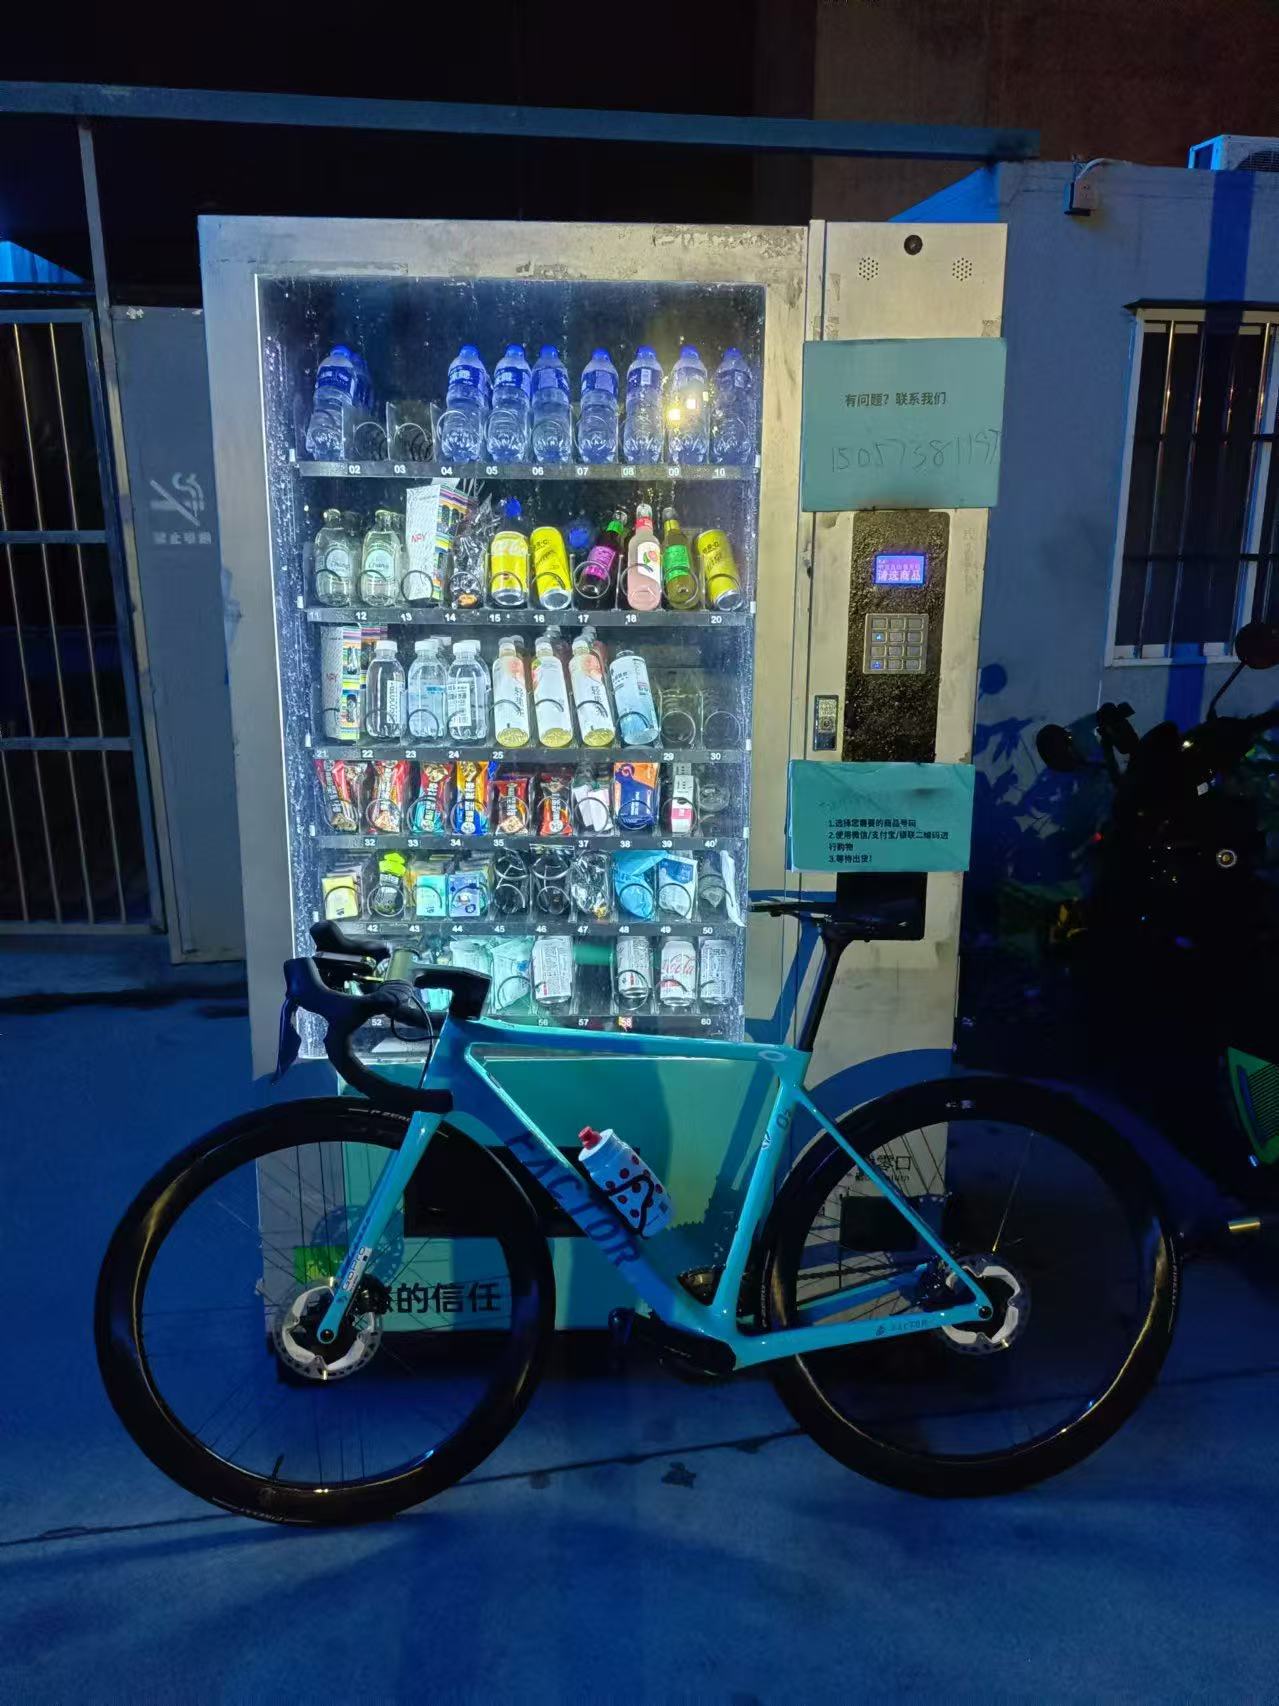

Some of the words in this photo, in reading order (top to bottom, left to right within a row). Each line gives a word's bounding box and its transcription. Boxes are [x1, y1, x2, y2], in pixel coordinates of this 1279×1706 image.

[349, 465, 361, 475] 02
[394, 465, 406, 474] 03
[441, 466, 453, 475] 04
[486, 466, 498, 475] 05
[532, 467, 543, 475] 06
[577, 467, 589, 475] 07
[623, 467, 634, 476] 08
[669, 467, 680, 476] 09
[714, 468, 726, 476] 10
[356, 612, 367, 620] 12
[401, 613, 412, 621] 13
[445, 613, 456, 622] 14
[534, 615, 545, 623] 16
[578, 615, 589, 623] 17
[626, 615, 637, 623] 18
[711, 616, 722, 624] 20
[362, 750, 373, 758] 22
[406, 750, 416, 758] 23
[449, 750, 460, 758] 24
[493, 751, 504, 759] 25
[663, 752, 674, 760] 29
[450, 839, 461, 847] 34
[493, 839, 504, 847] 35
[578, 840, 588, 848] 37
[620, 840, 630, 848] 38
[662, 840, 672, 848] 39
[705, 840, 715, 848] 40
[661, 926, 671, 934] 49
[703, 927, 713, 935] 50
[579, 1018, 588, 1026] 57
[700, 1018, 711, 1026] 60
[385, 1282, 501, 1314] 的信任
